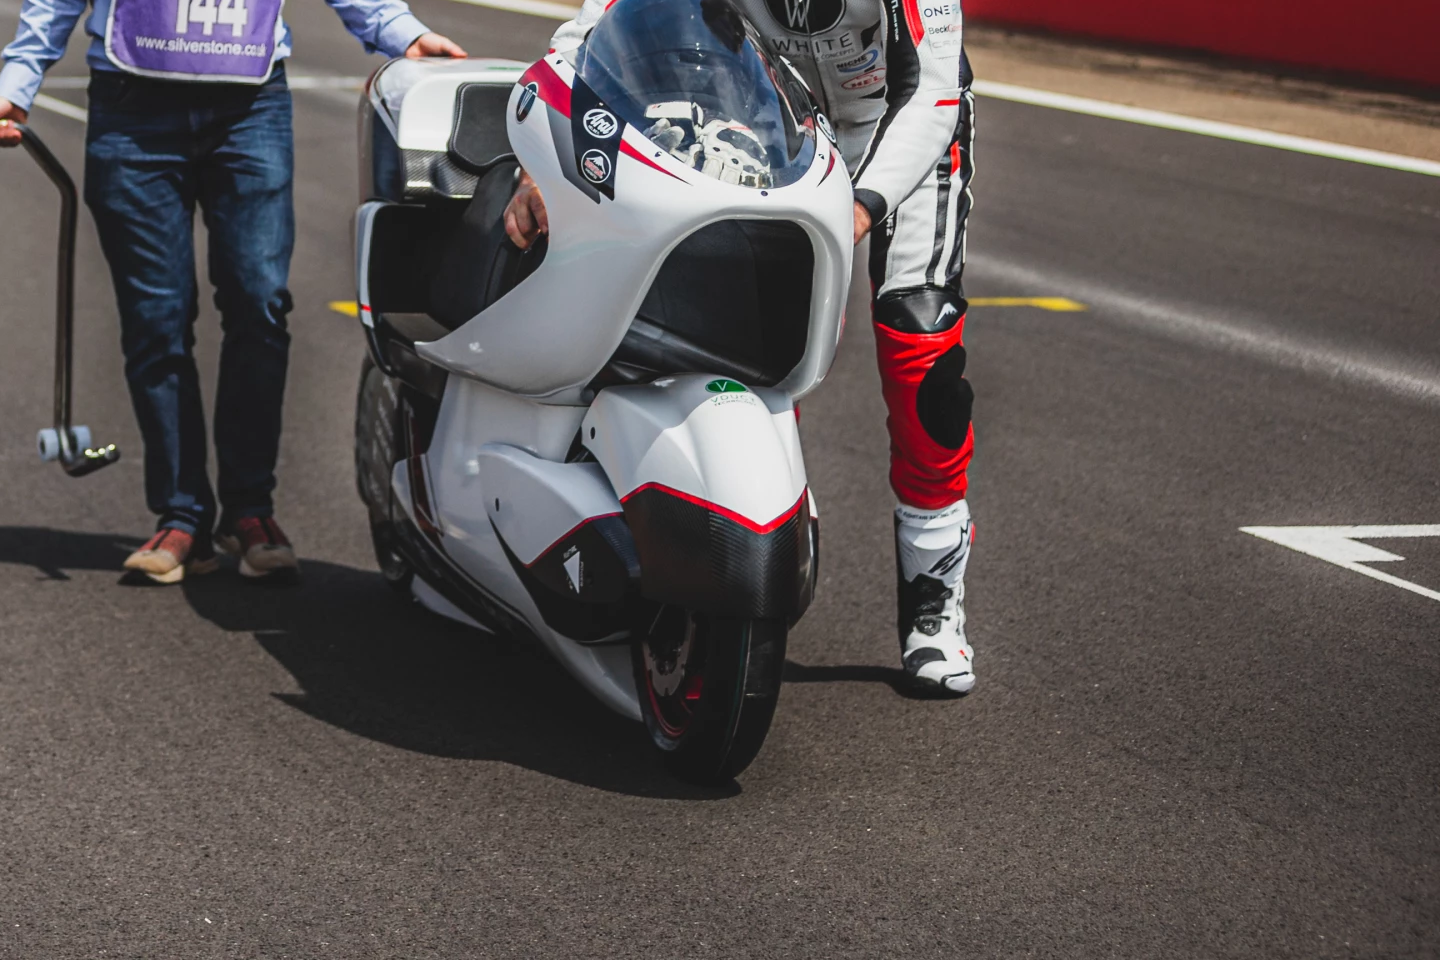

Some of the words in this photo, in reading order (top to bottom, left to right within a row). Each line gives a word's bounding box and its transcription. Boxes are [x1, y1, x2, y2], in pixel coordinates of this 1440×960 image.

[923, 5, 951, 19] ONE
[135, 35, 267, 58] www.silverstone.co.uk
[771, 32, 853, 55] WHITE
[836, 53, 868, 69] NICHE
[588, 112, 613, 135] Arai
